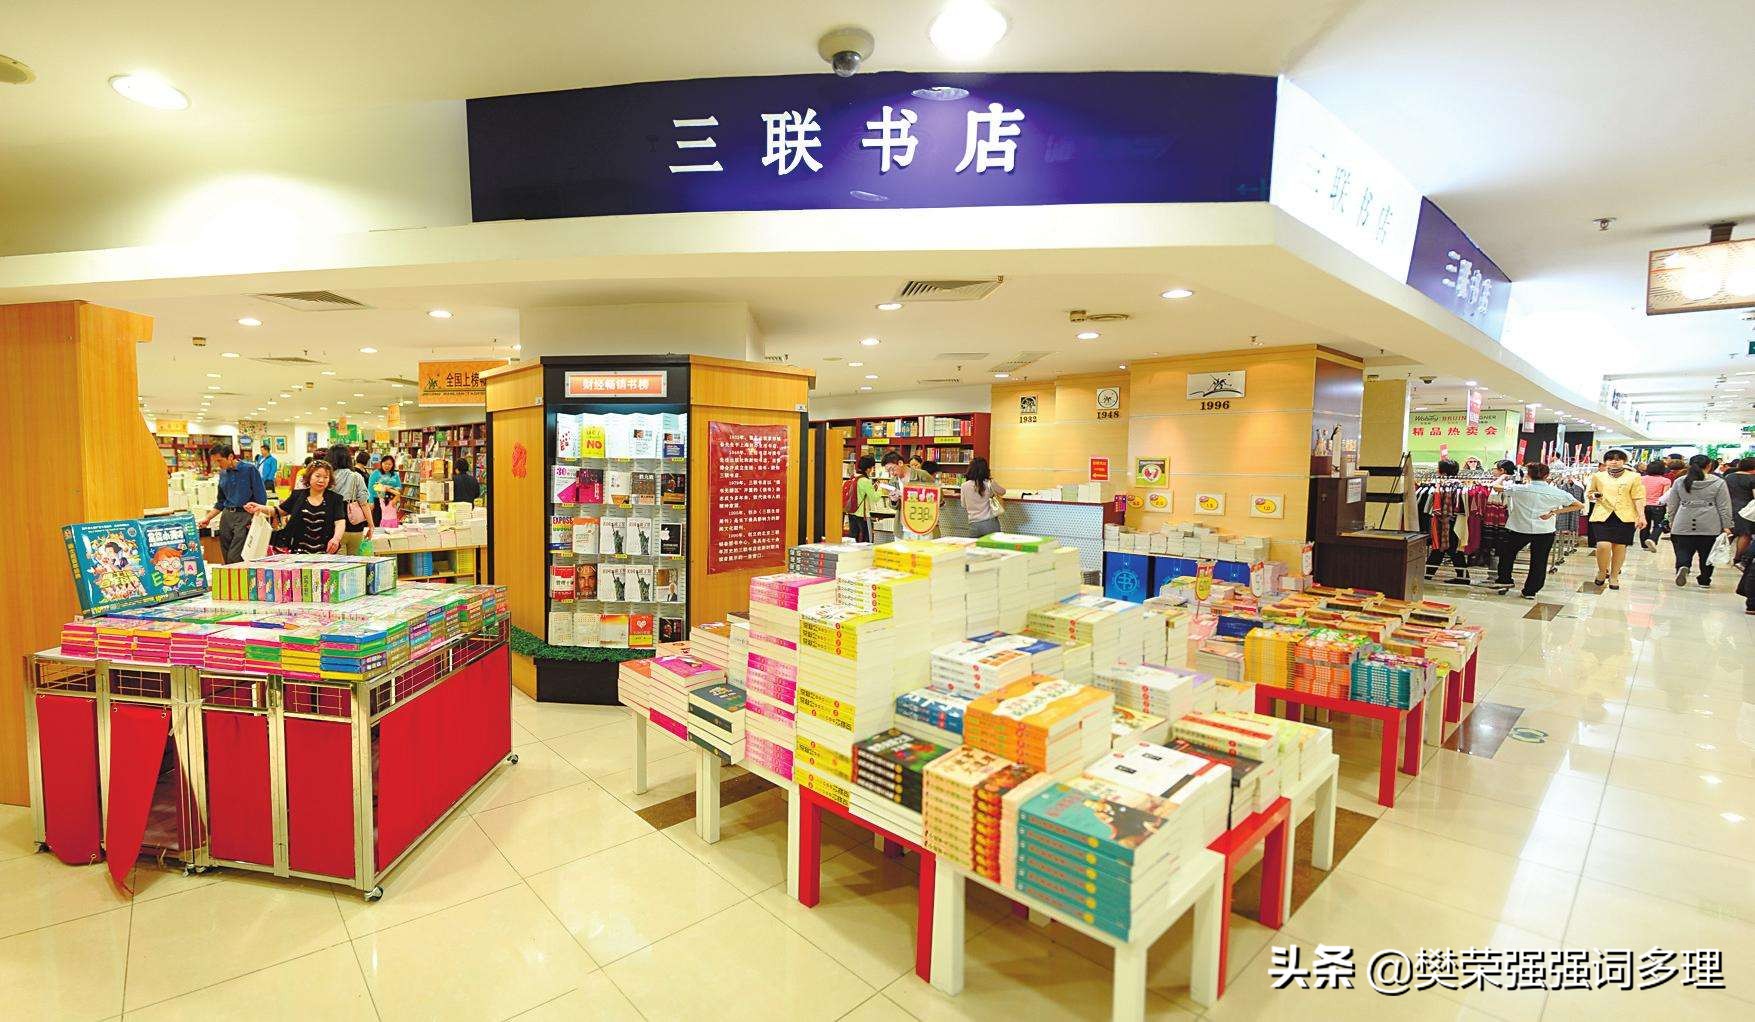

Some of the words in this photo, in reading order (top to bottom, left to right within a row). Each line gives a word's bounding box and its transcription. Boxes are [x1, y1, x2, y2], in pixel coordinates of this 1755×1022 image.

[669, 102, 1025, 175] 三联书店
[582, 378, 649, 391] 财经畅销书榜
[1200, 400, 1230, 411] 1996
[1019, 415, 1037, 424] 1932
[1097, 410, 1120, 420] 1948
[1412, 426, 1498, 436] 精品热卖会
[586, 440, 602, 450] NO
